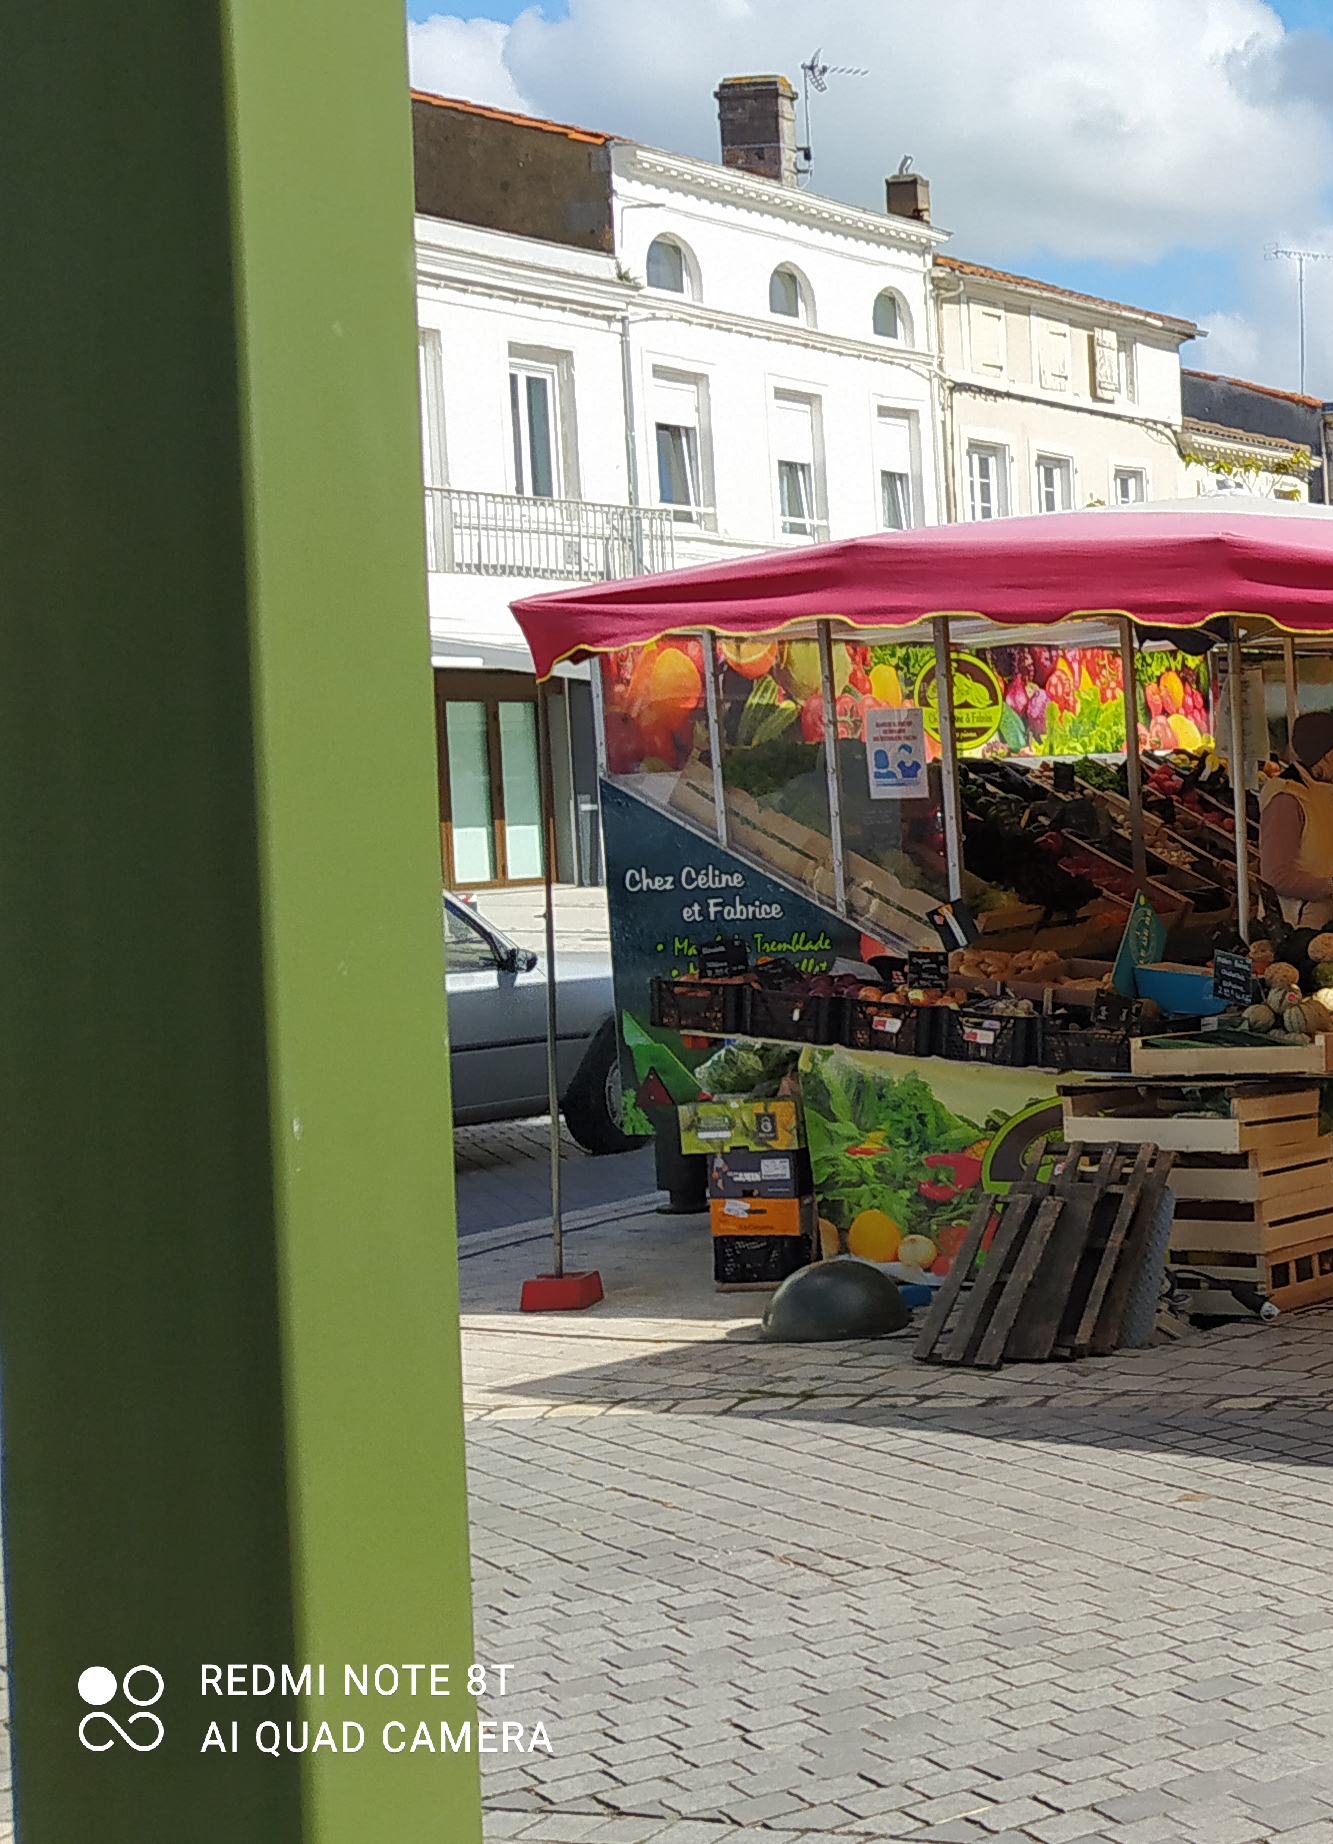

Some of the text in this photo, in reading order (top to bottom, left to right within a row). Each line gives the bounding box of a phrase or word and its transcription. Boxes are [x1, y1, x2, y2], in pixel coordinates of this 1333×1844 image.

[625, 864, 745, 892] Chez Céline
[682, 895, 783, 922] et Fabrice
[753, 931, 831, 953] Tremblade
